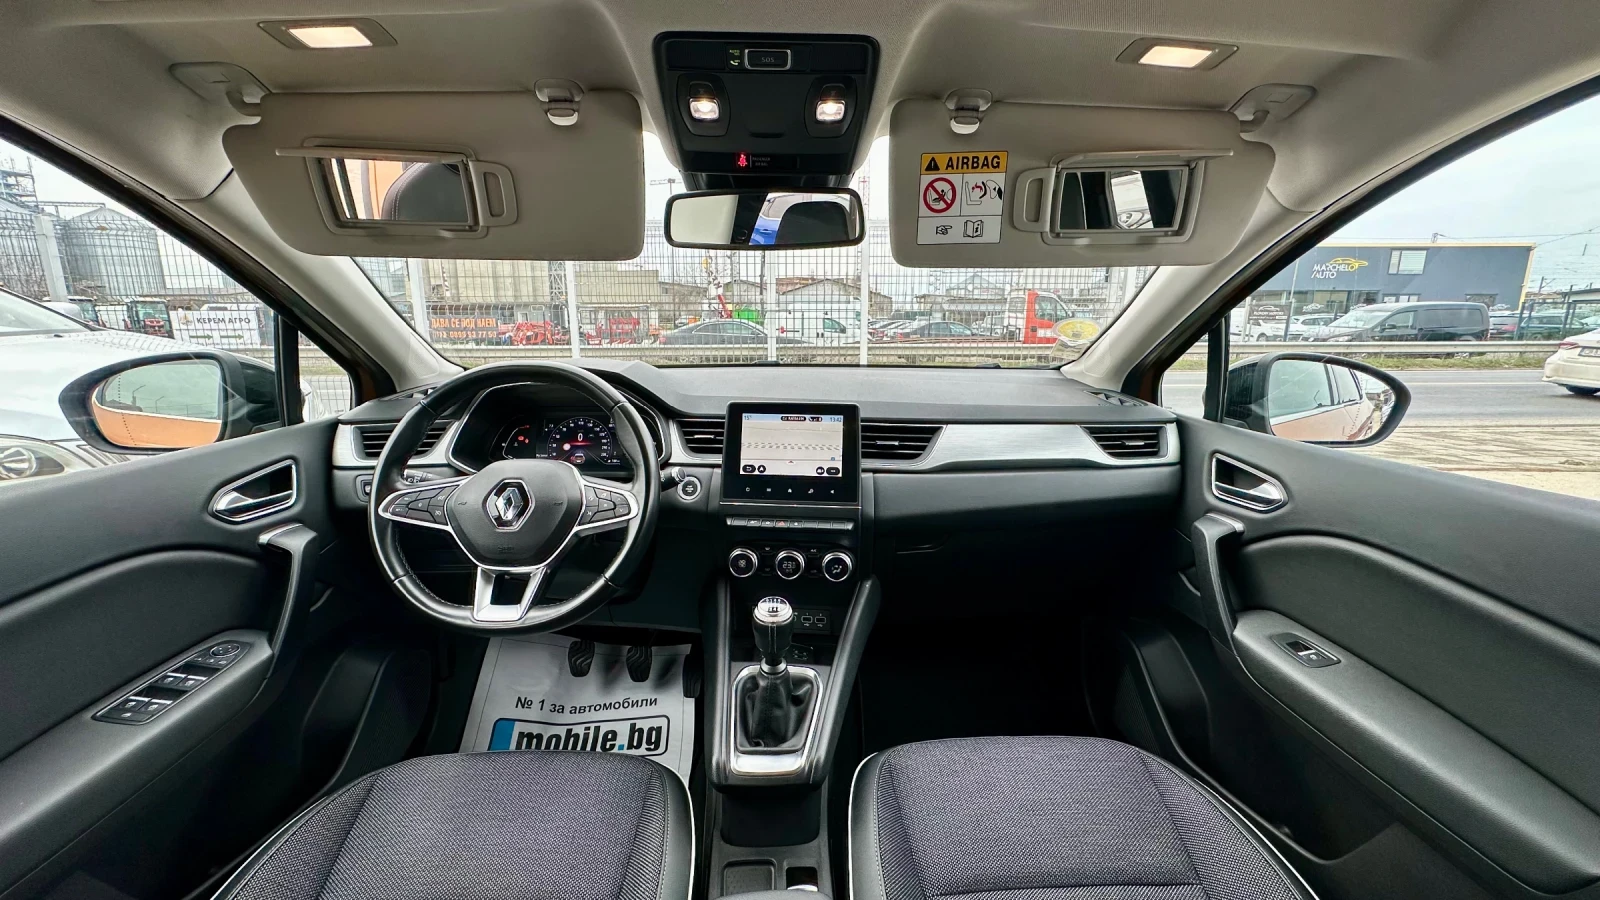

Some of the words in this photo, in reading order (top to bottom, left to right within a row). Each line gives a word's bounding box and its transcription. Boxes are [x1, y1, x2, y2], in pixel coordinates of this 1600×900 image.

[945, 155, 1001, 170] AIRBAG
[1311, 271, 1337, 279] AUTO
[1312, 263, 1356, 272] MARCHELO
[515, 696, 533, 709] №
[538, 699, 545, 711] 1
[549, 704, 565, 714] за
[569, 697, 658, 715] автомобили
[515, 722, 663, 752] mobile.bg
